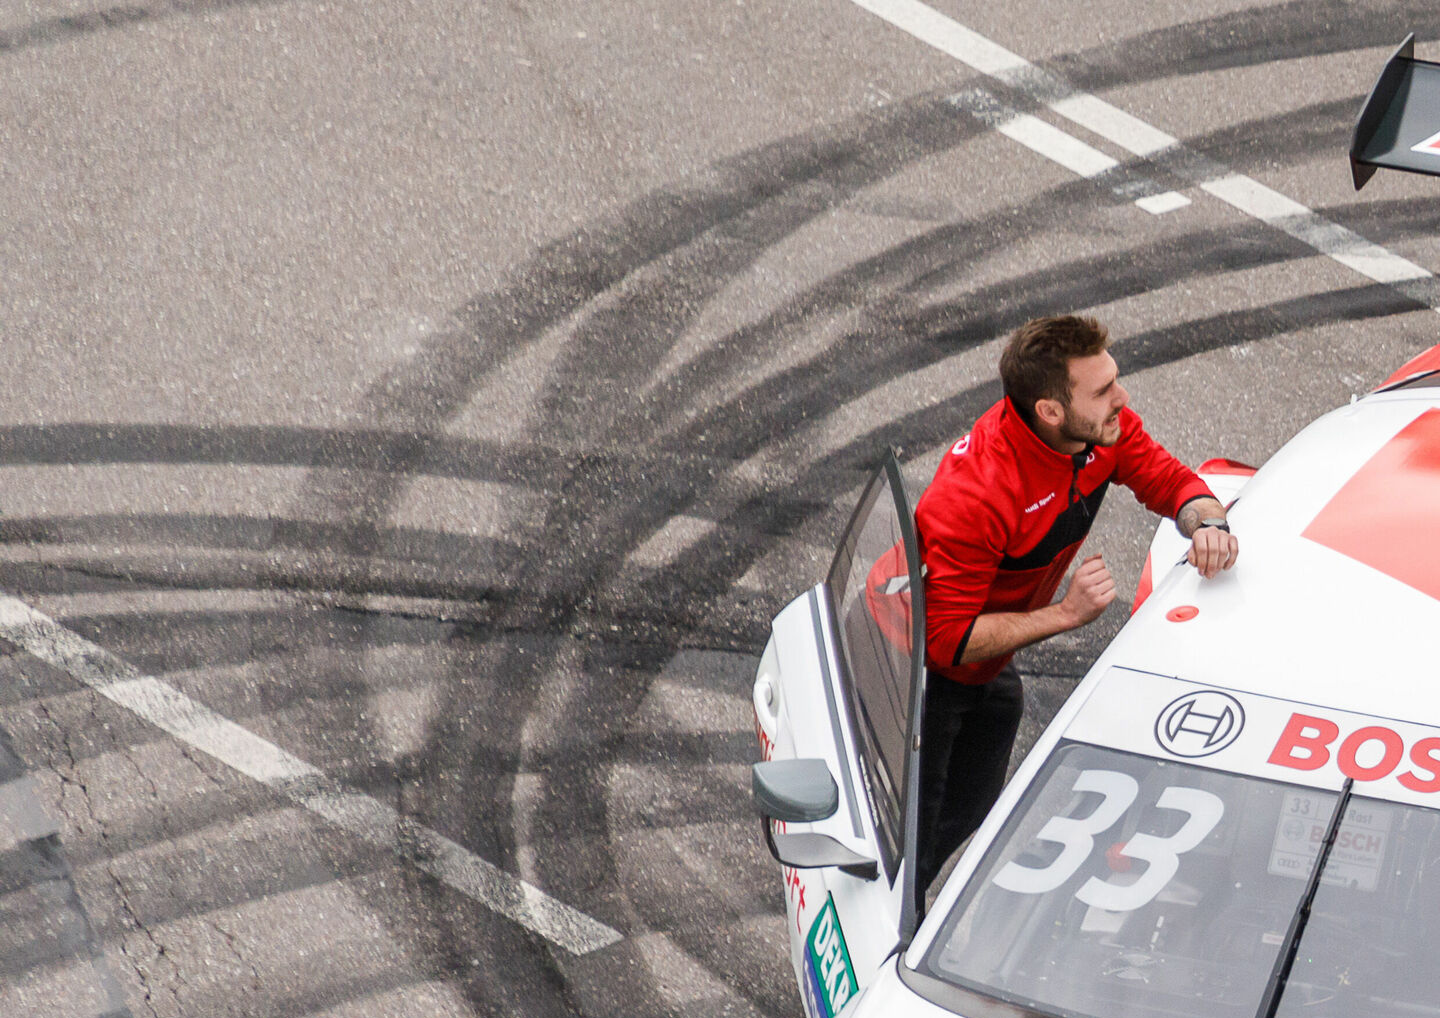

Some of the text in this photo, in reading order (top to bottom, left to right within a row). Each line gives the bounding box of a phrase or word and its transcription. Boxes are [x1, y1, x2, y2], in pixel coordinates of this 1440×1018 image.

[1290, 797, 1373, 824] 33 Rast
[992, 769, 1225, 912] 33
[1309, 825, 1382, 852] BSCH
